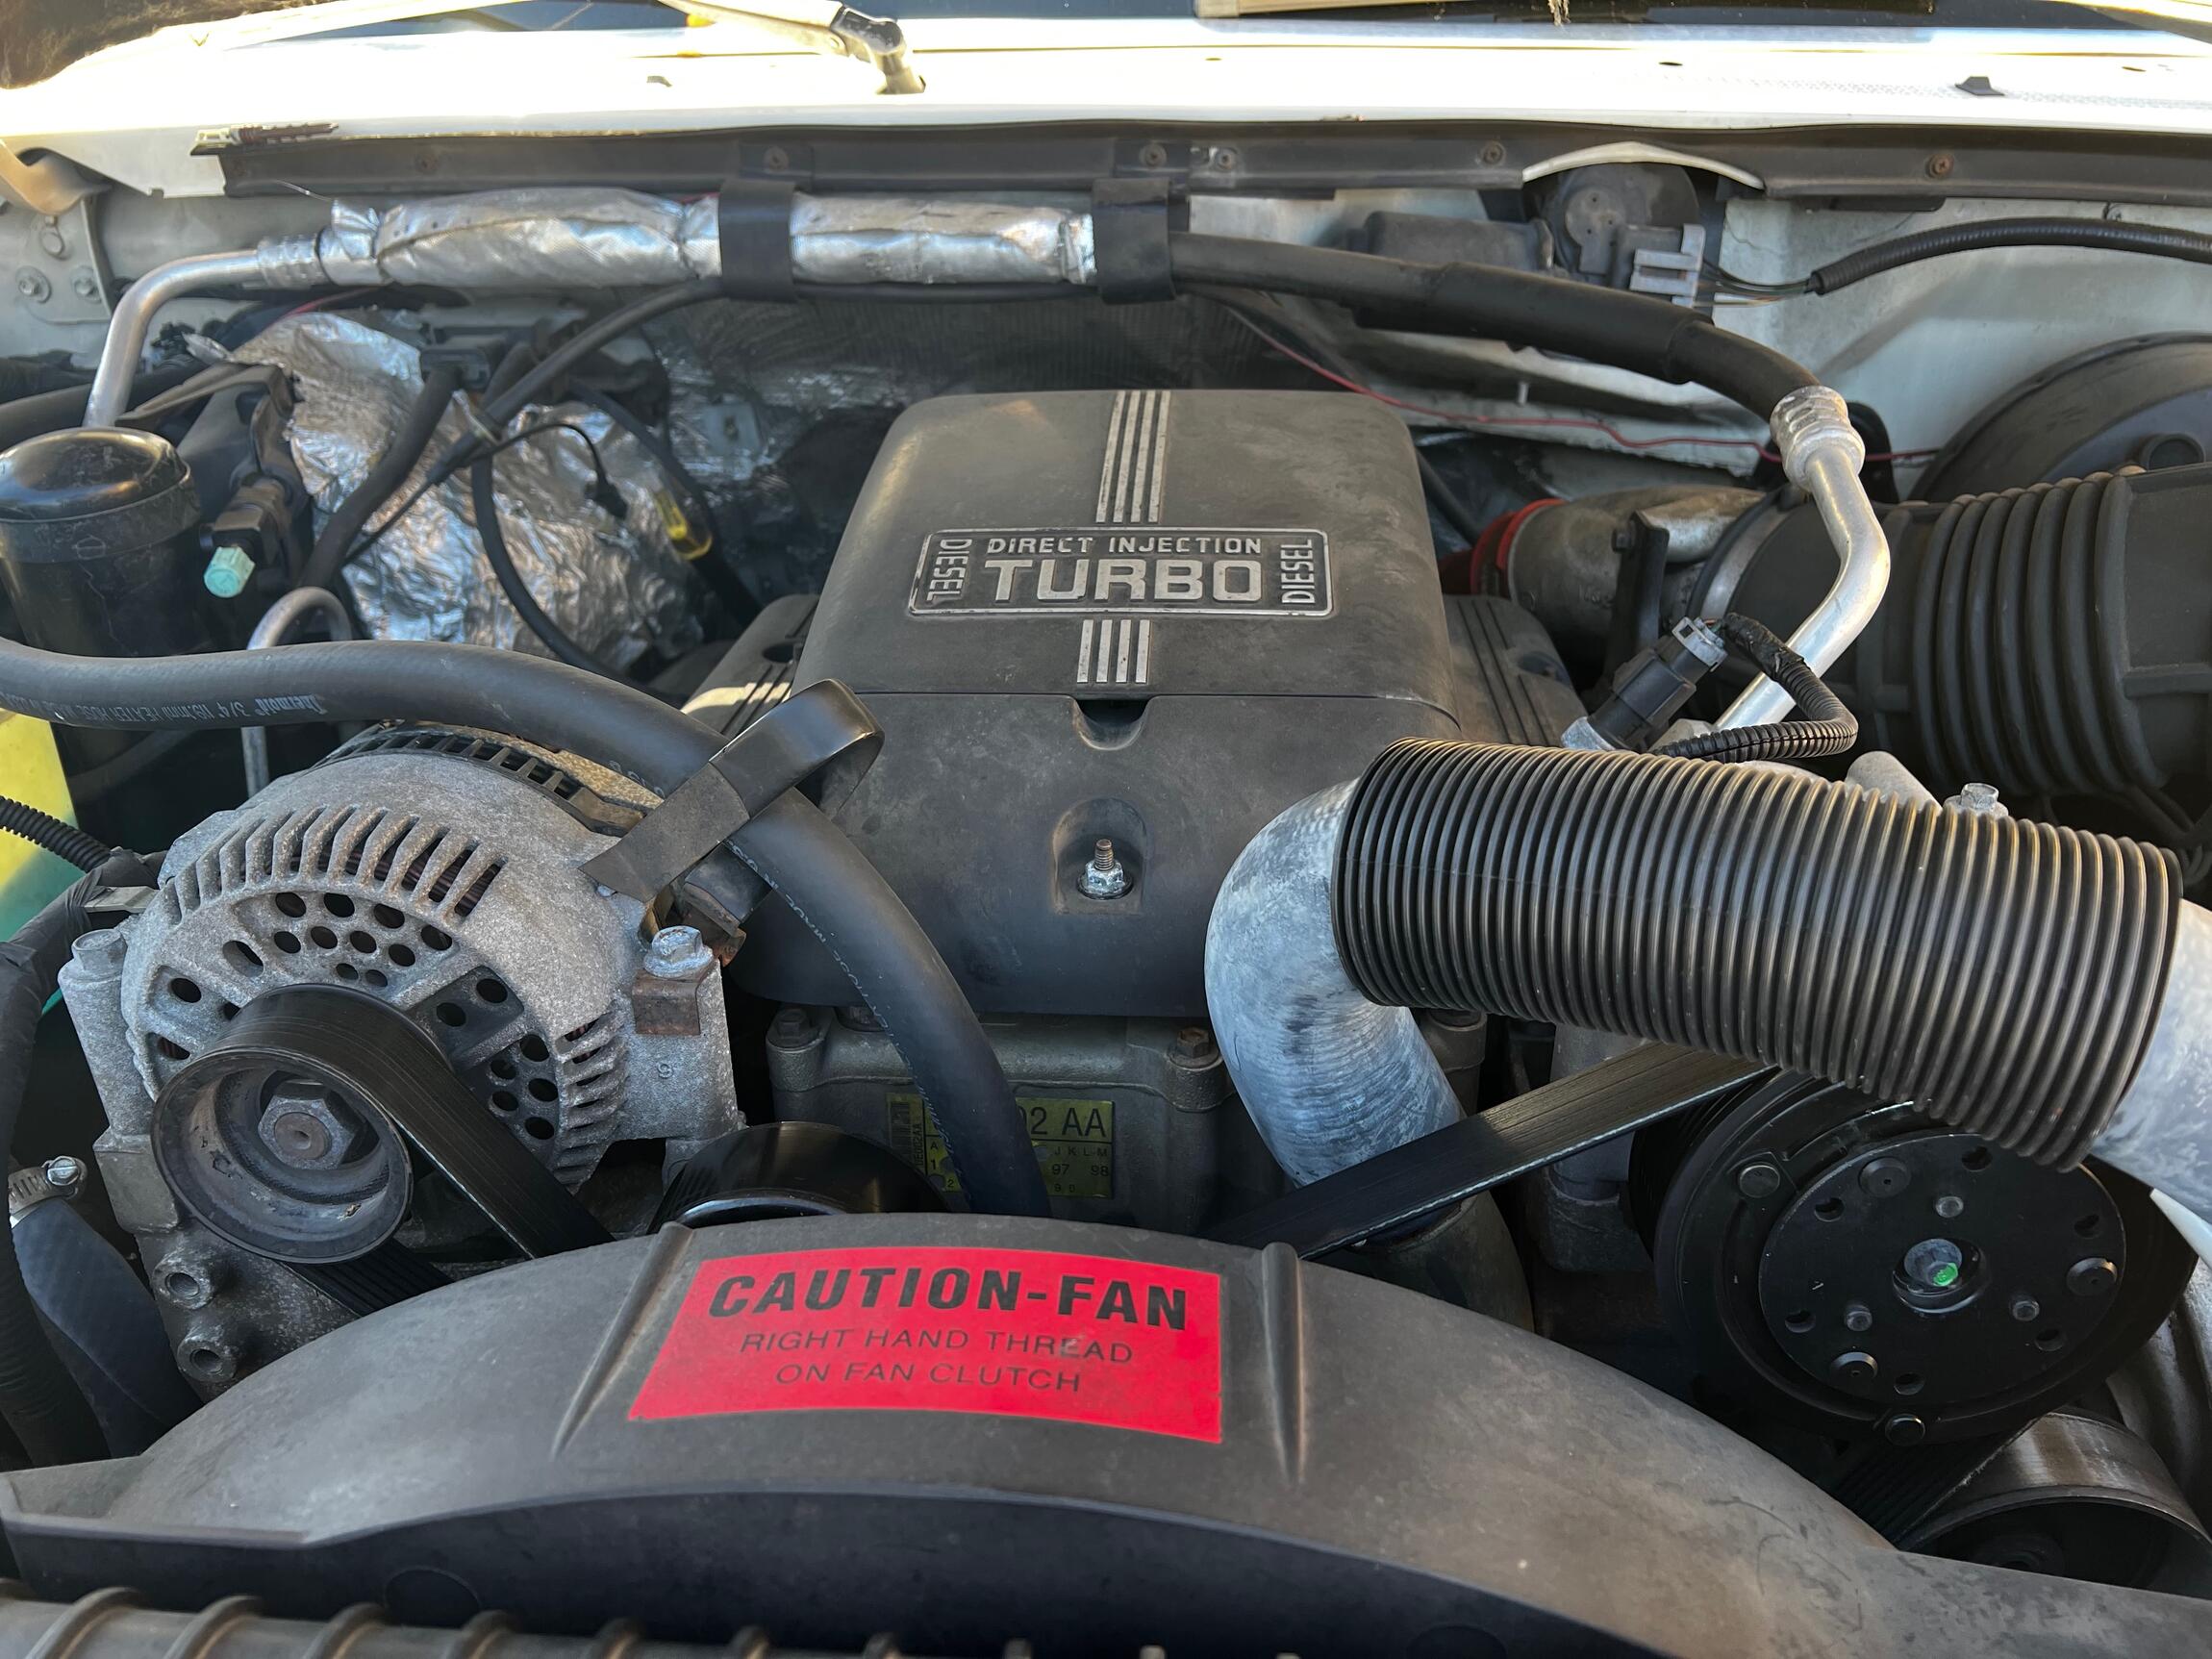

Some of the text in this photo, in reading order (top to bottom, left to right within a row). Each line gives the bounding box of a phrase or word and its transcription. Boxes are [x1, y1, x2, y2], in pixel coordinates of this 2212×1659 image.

[987, 537, 1262, 555] DIRECT INJECTION
[925, 539, 972, 602] DIESEL
[984, 558, 1263, 603] TURBO
[1280, 540, 1317, 605] DIESEL
[1061, 1106, 1108, 1138] AA
[1052, 1163, 1070, 1176] 97
[1091, 1165, 1110, 1178] 98
[708, 1267, 1187, 1332] CAUTION-FAN
[740, 1327, 1133, 1364] RIGHT HAND THREAD
[775, 1363, 1081, 1393] ON FAN CLUTCH
